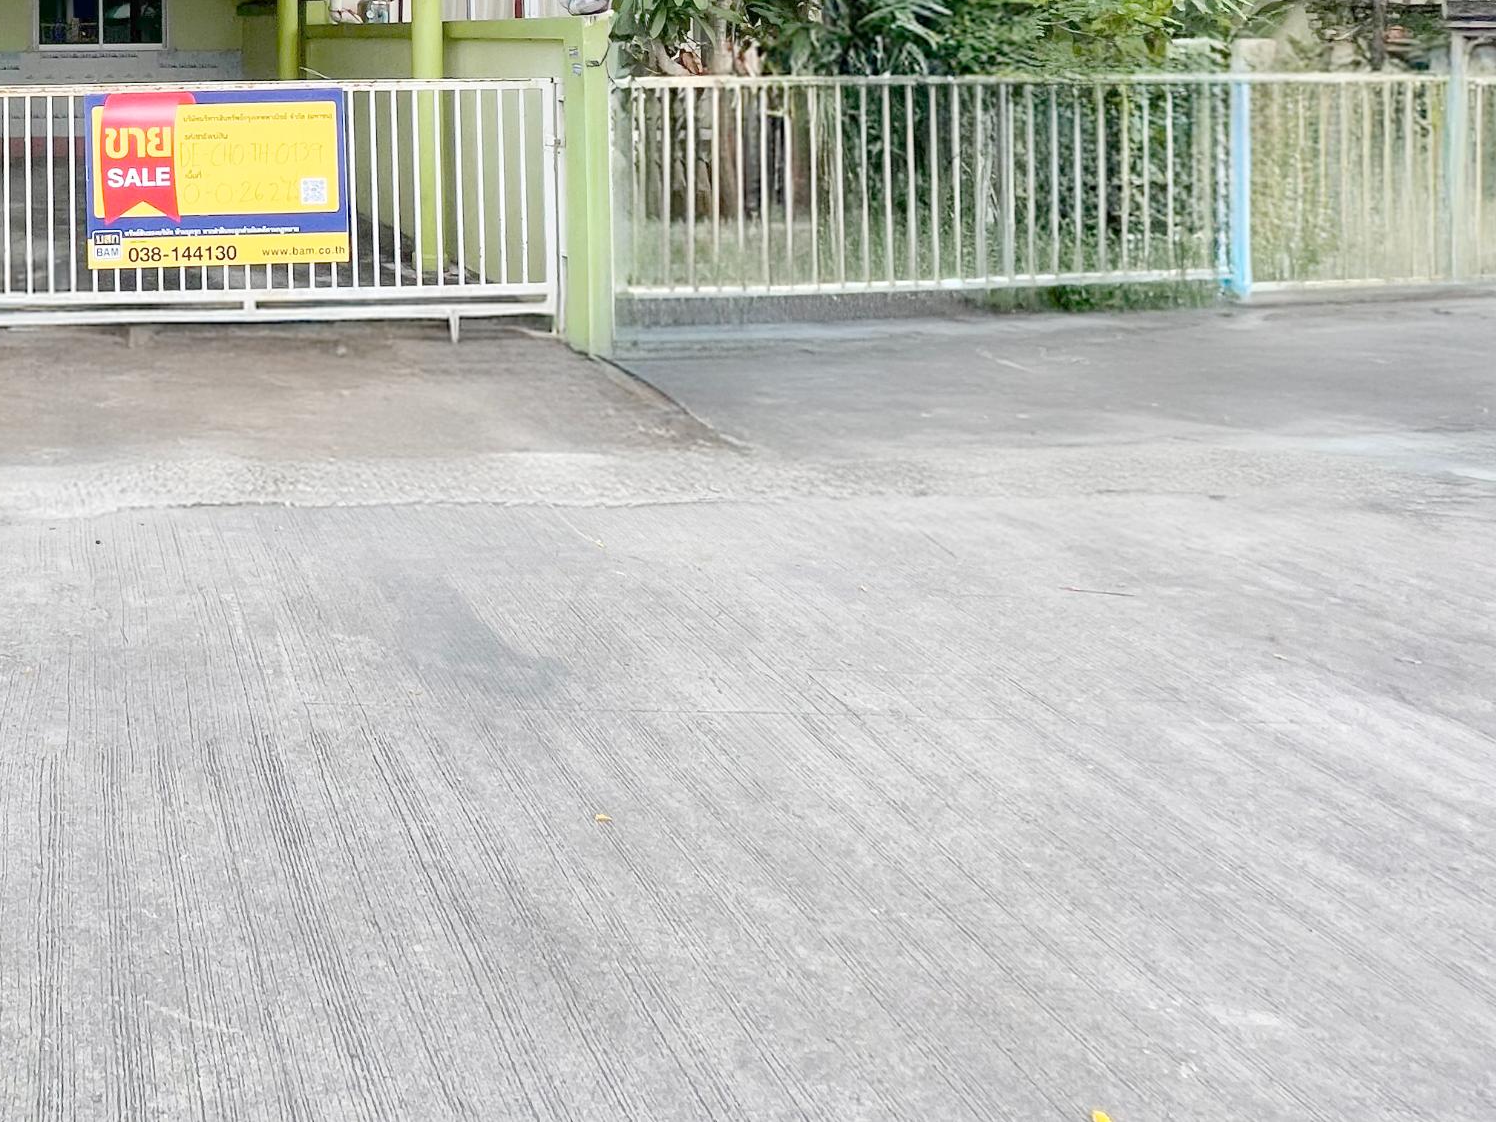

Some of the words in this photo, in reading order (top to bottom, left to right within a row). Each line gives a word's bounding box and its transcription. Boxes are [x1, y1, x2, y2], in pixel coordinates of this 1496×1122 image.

[105, 126, 172, 159] ขาย
[106, 166, 171, 188] SALE
[96, 247, 119, 257] BAM
[128, 245, 237, 262] 038-144130
[262, 245, 346, 257] www.bam.co.th
